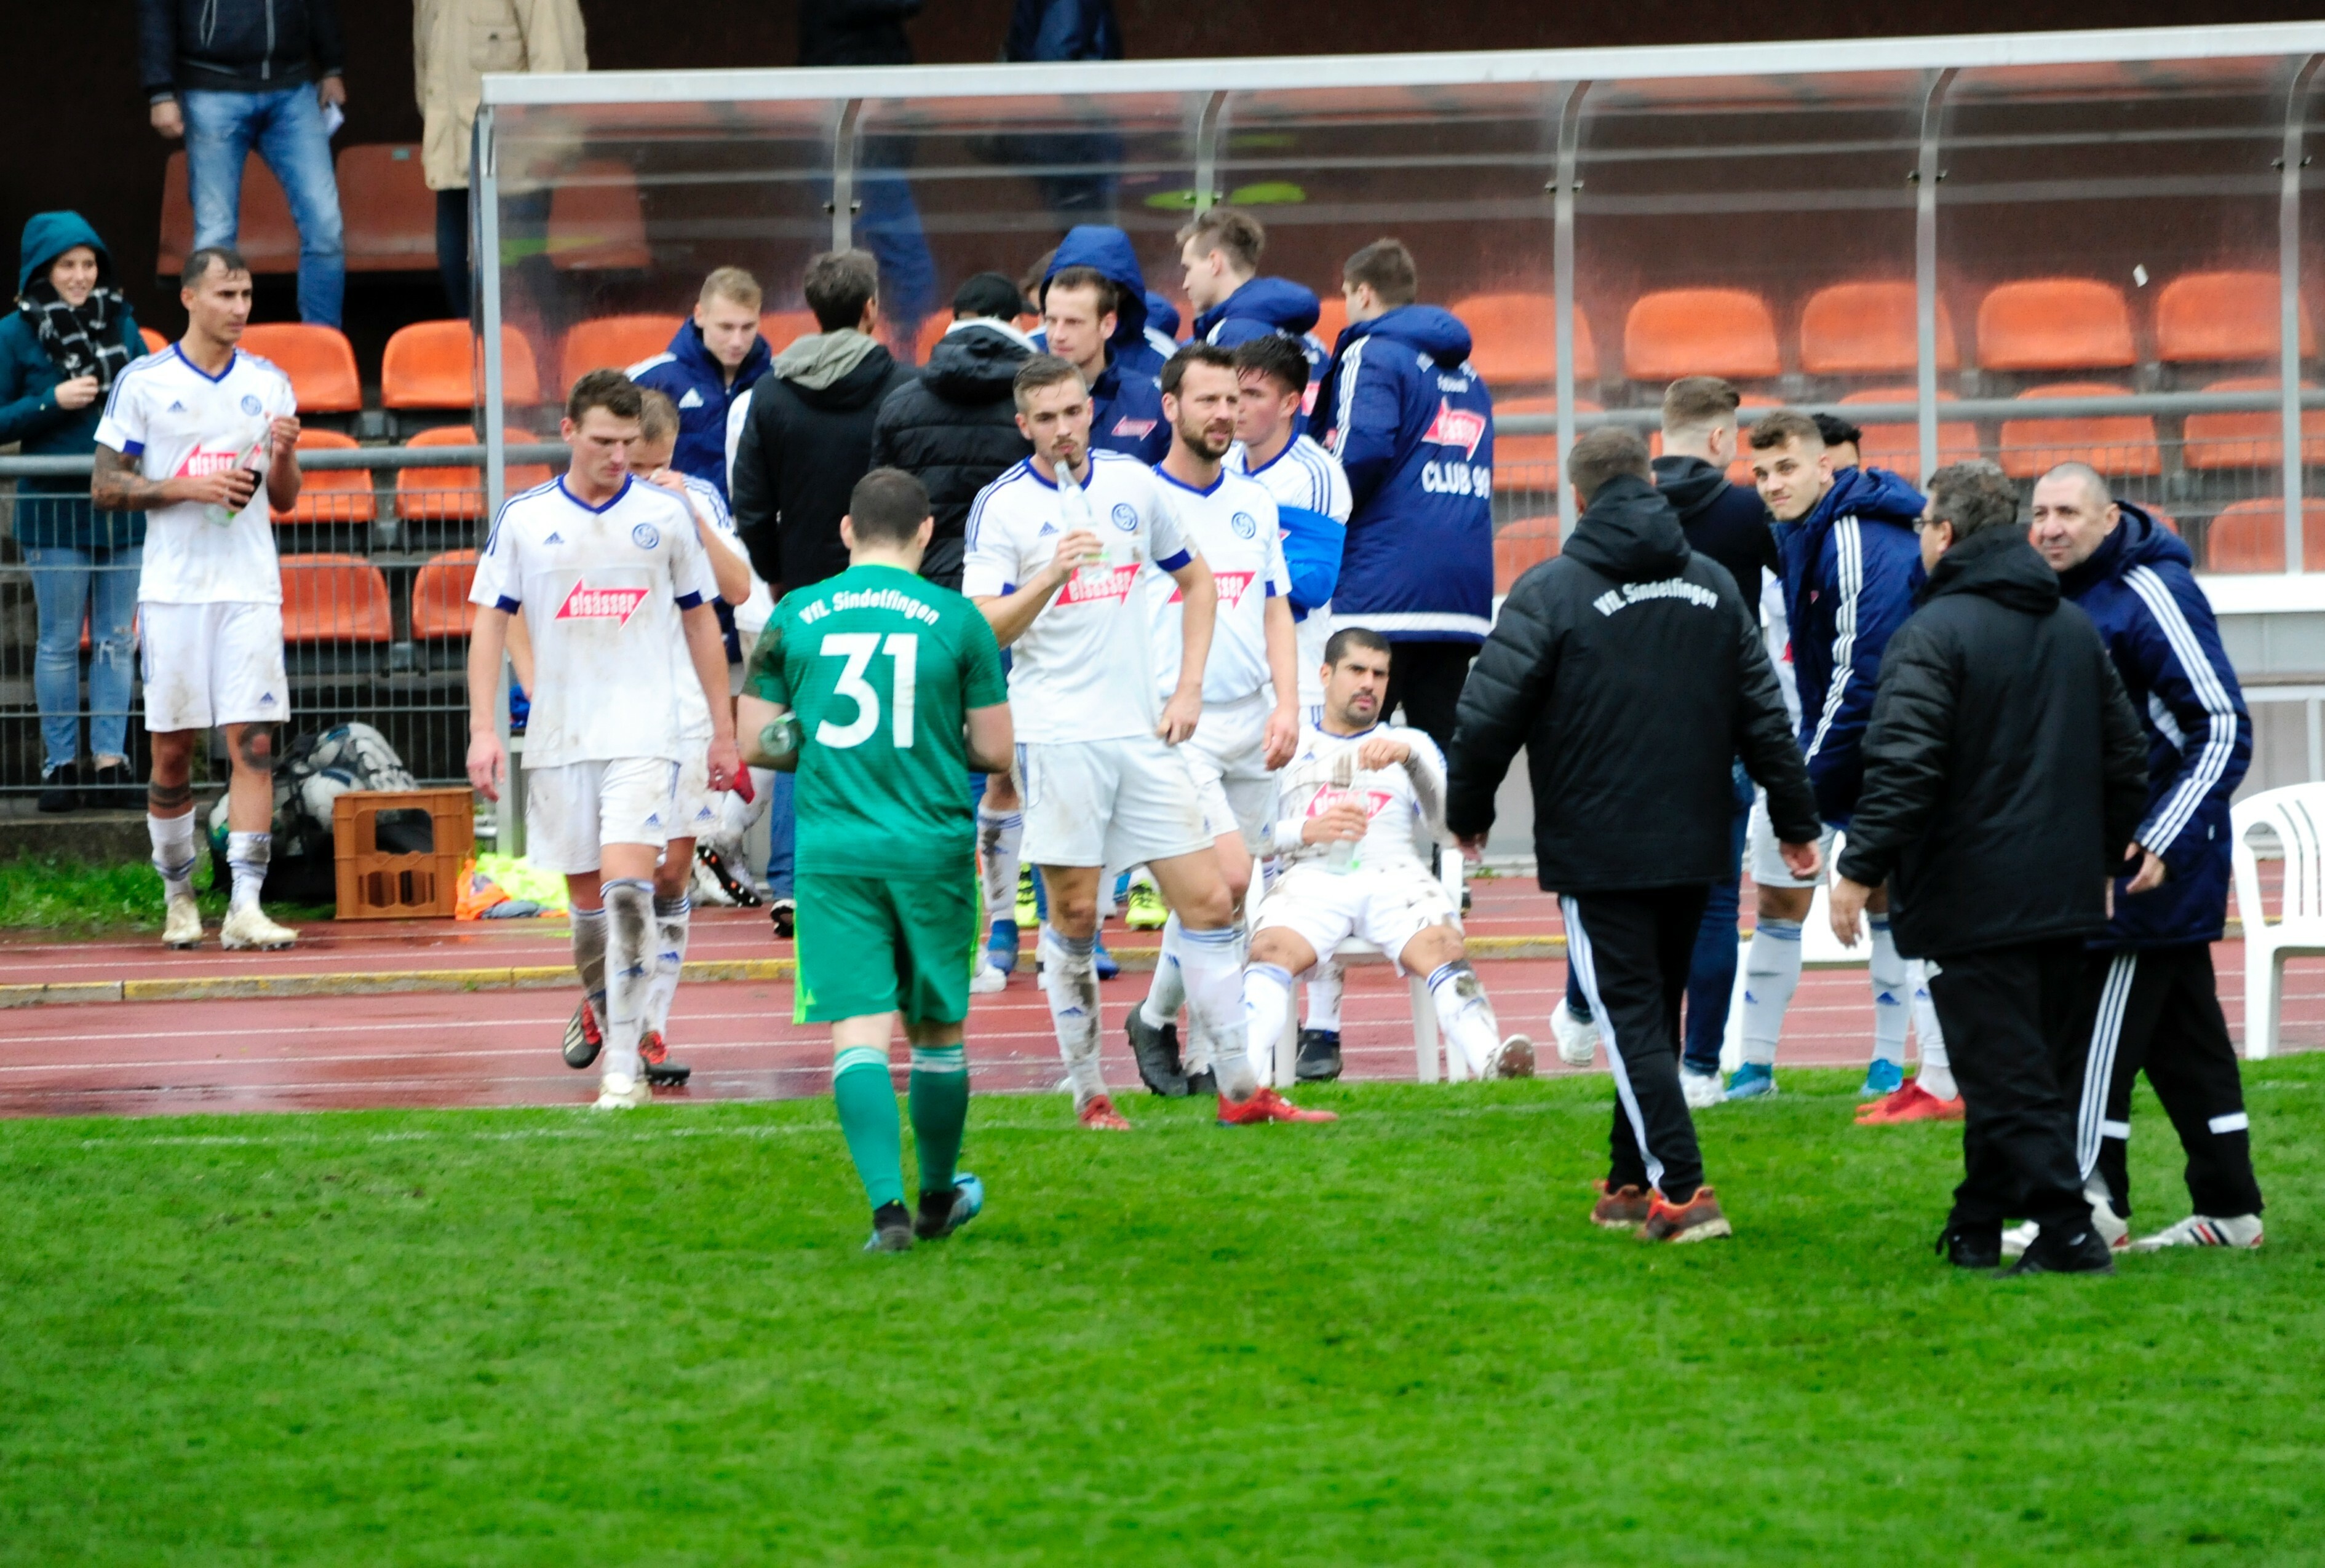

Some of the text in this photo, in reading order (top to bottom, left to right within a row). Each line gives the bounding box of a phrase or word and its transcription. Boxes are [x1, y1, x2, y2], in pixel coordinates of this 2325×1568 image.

[1421, 461, 1472, 495] CLUB
[798, 587, 940, 626] VfL Sindelfingen
[1592, 577, 1719, 617] VfL Sindelfingen
[814, 632, 918, 749] 31
